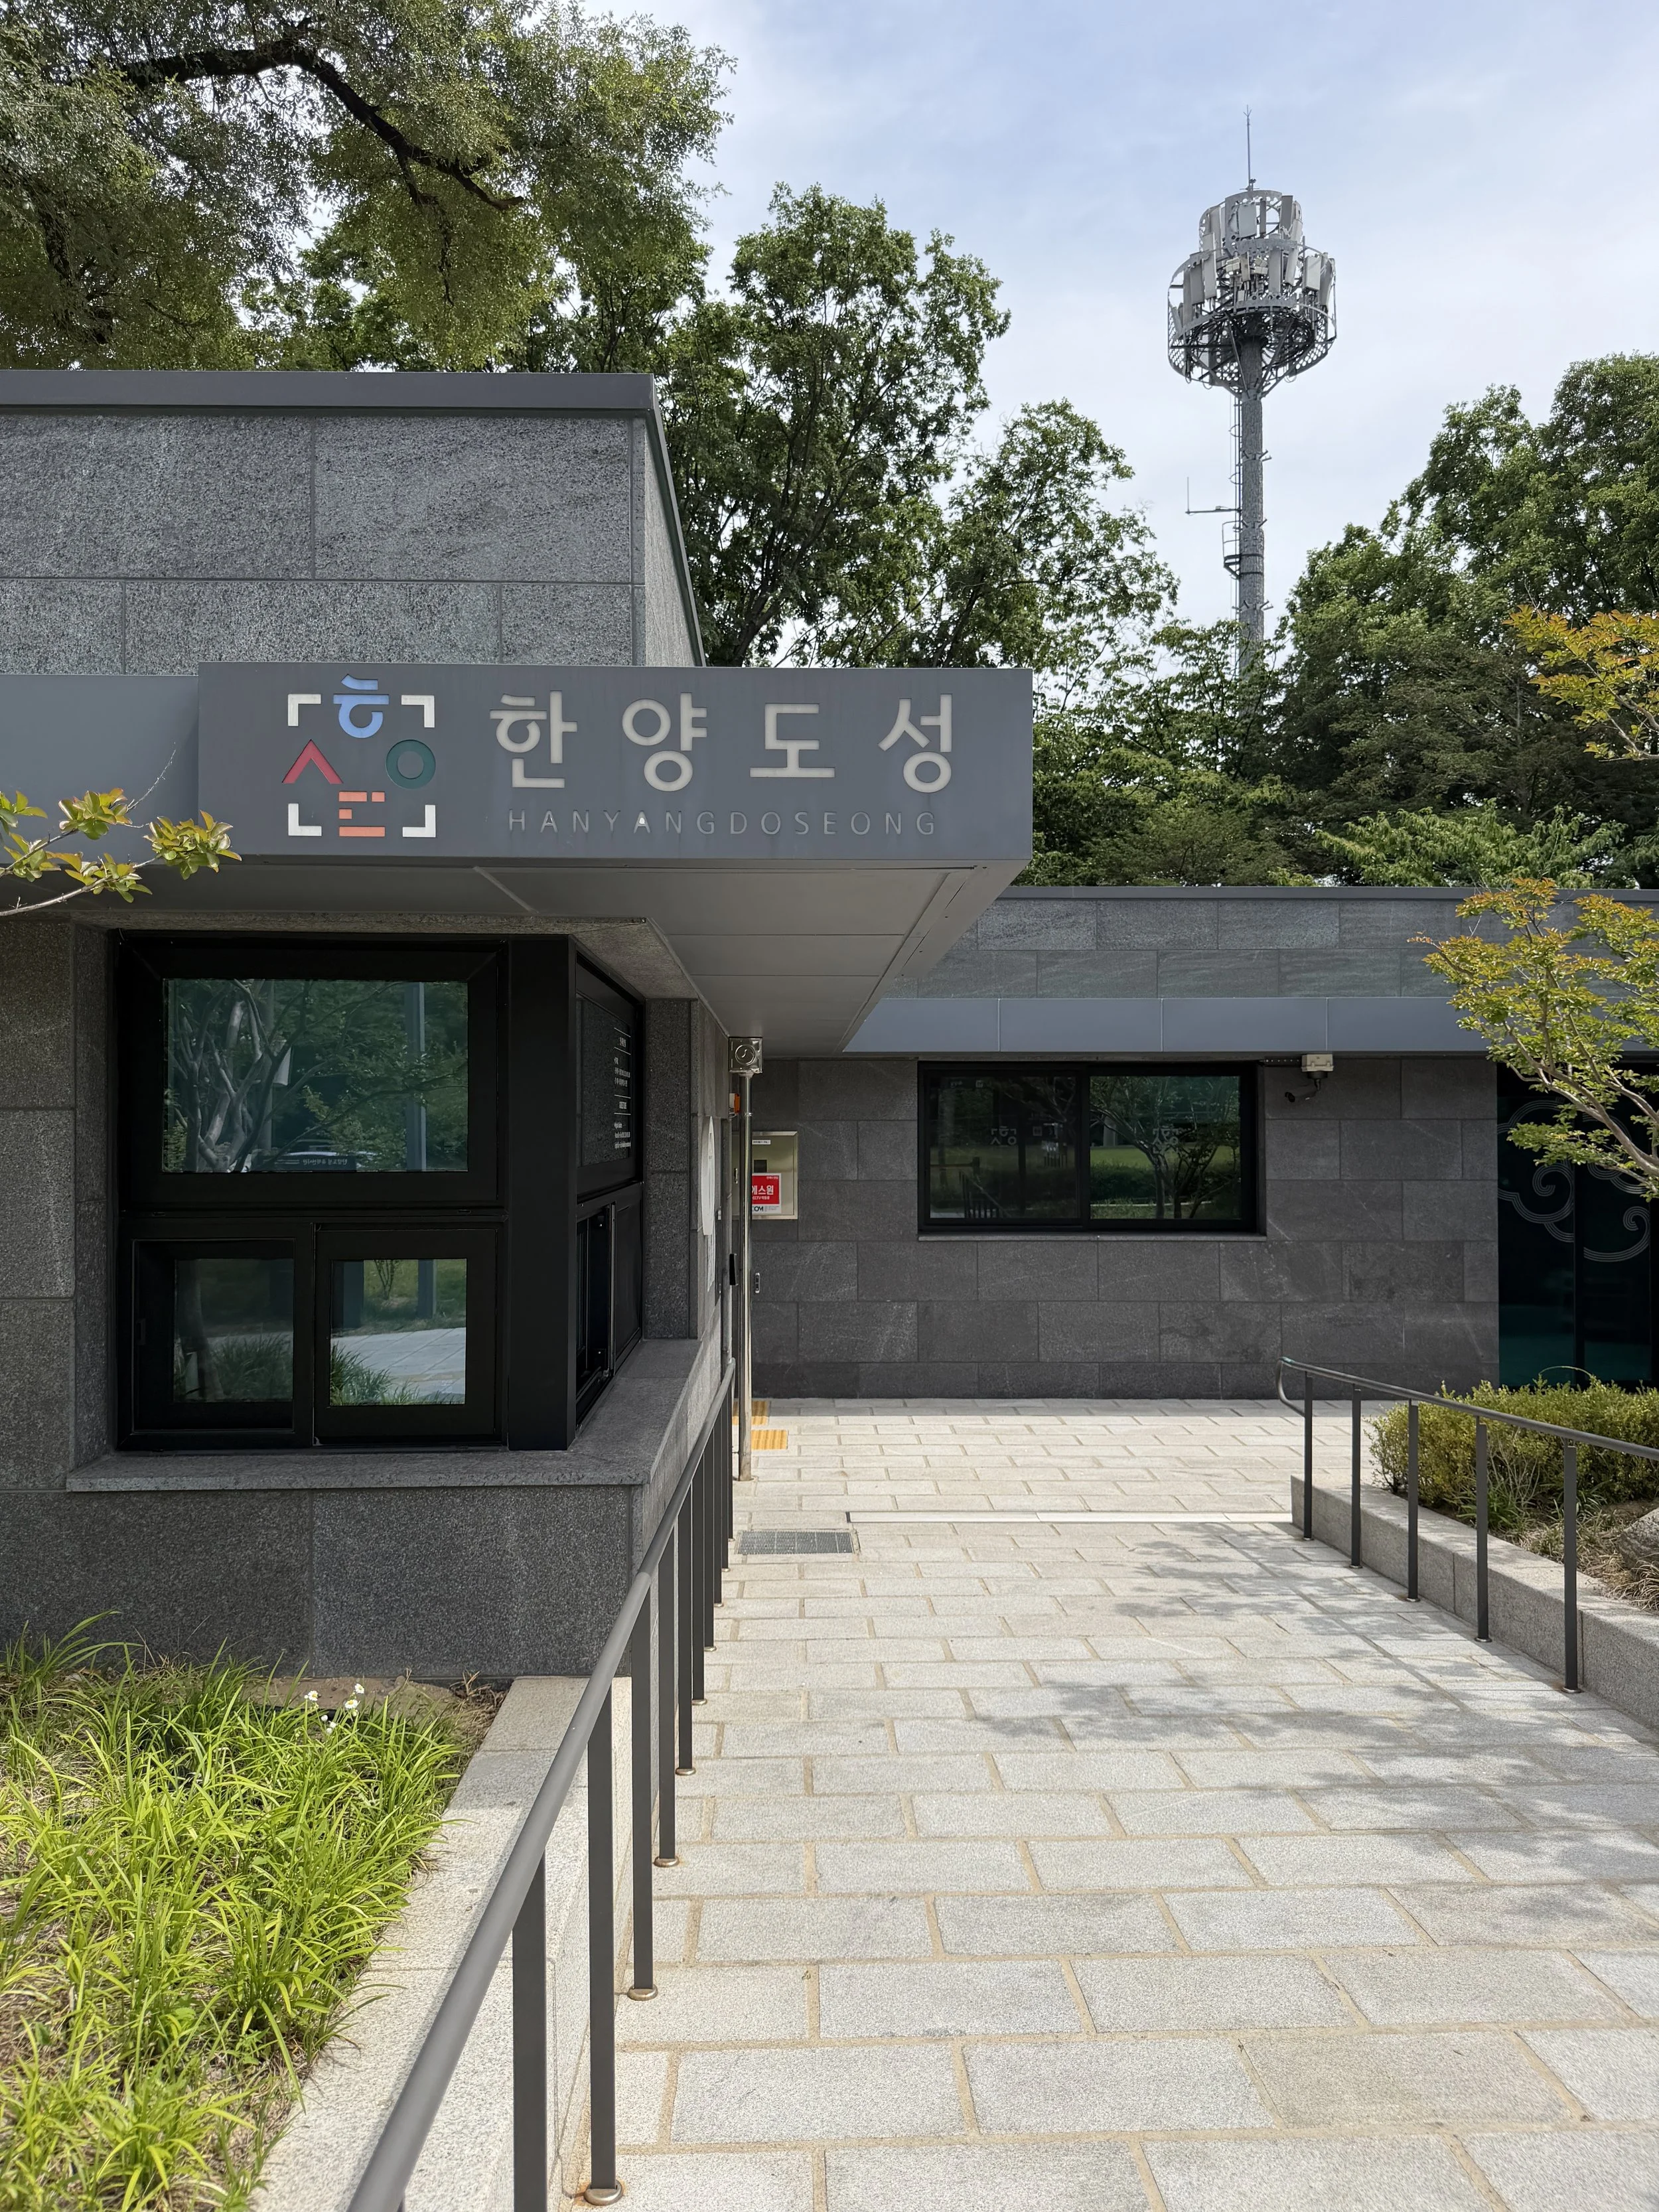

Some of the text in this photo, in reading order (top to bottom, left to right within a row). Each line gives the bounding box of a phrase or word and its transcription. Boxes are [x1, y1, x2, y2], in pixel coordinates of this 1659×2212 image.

[490, 690, 953, 794] 한양도성
[508, 809, 935, 836] HANYANGDOSEONG
[752, 1185, 774, 1195] 에스원
